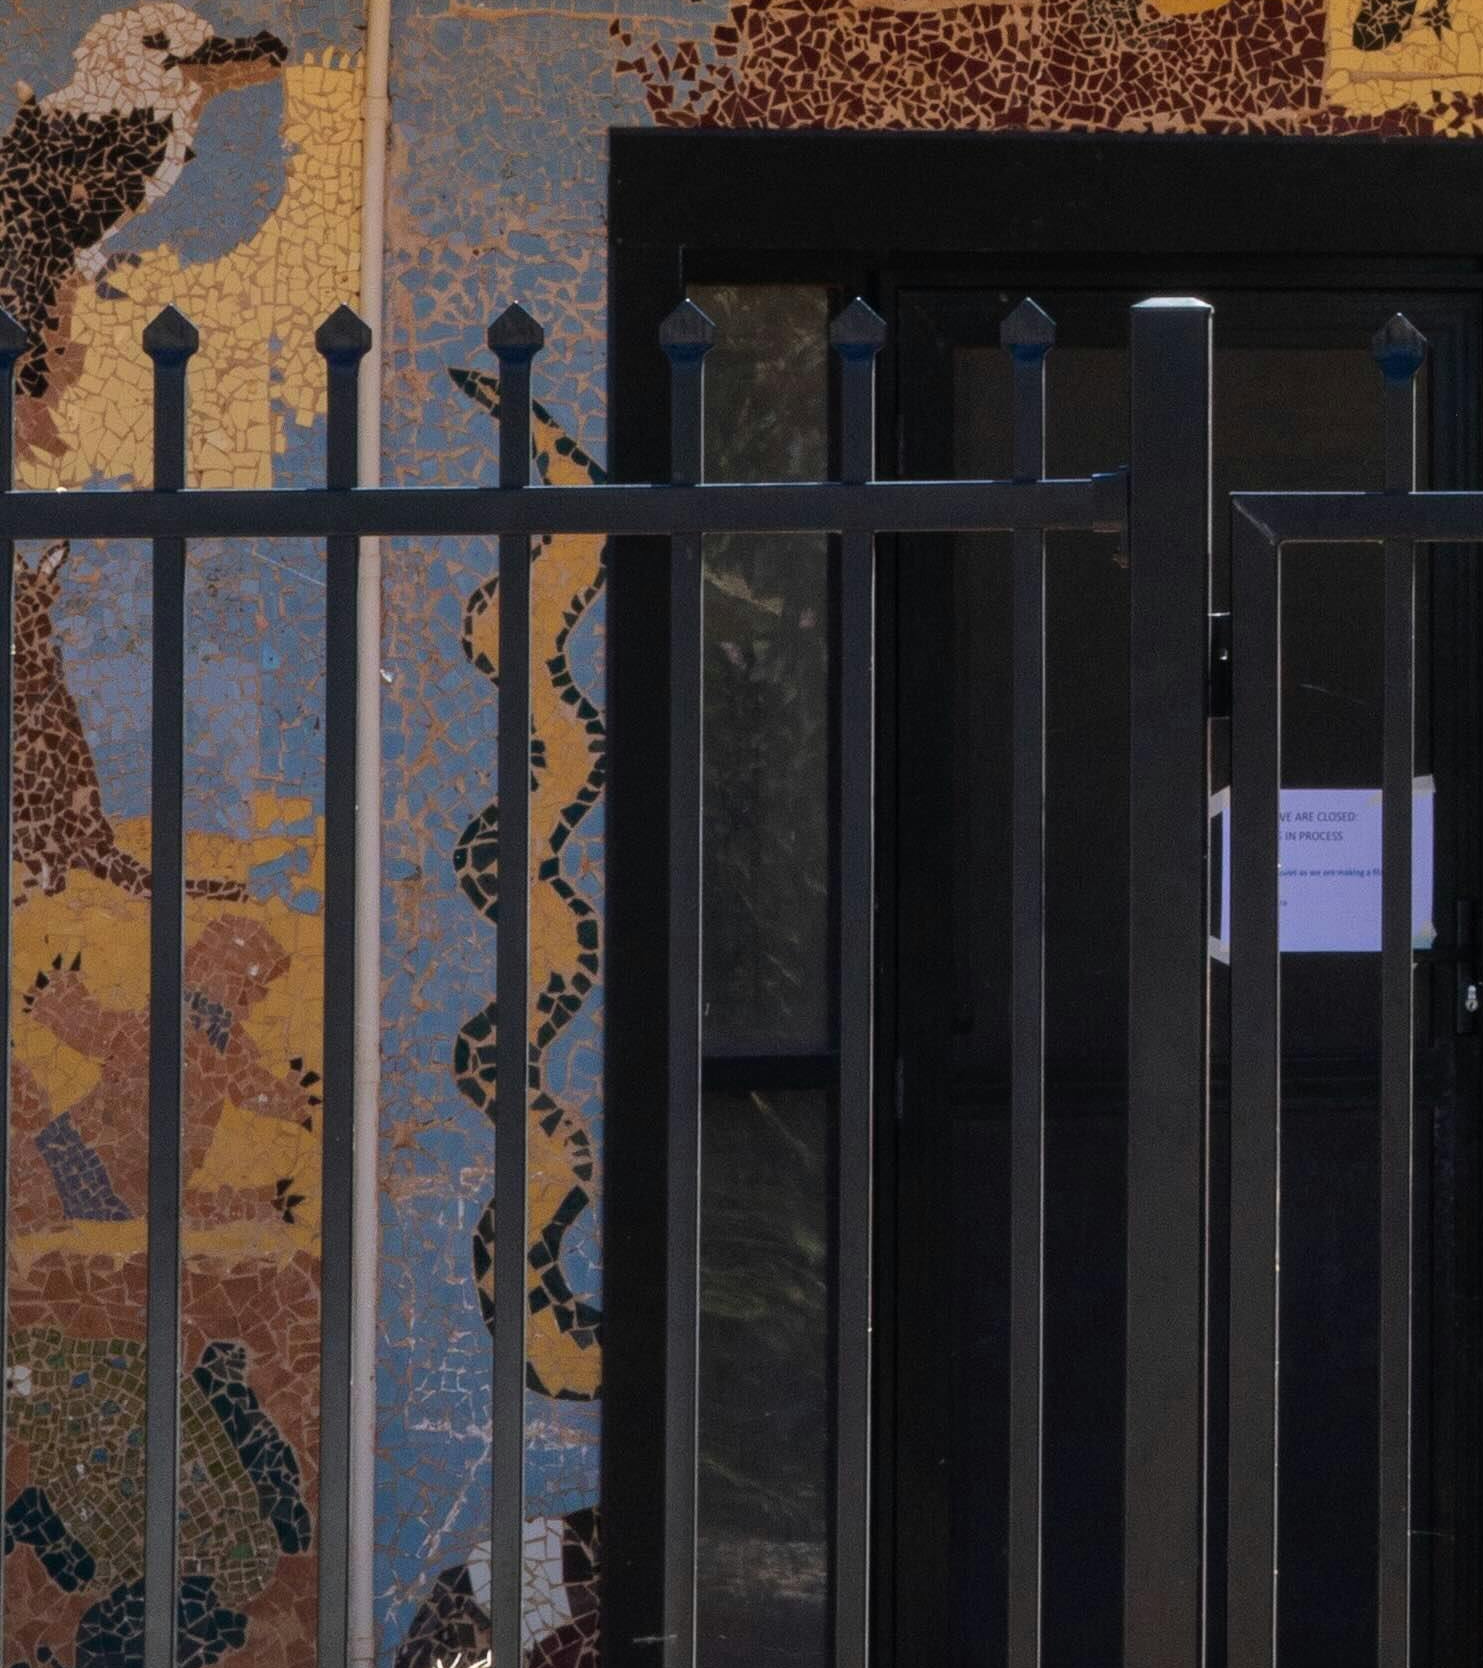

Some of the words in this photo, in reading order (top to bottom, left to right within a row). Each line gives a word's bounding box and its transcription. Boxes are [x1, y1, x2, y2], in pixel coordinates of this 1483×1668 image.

[1295, 812, 1313, 822] ARE
[1285, 831, 1297, 841] IN
[1299, 831, 1343, 840] PROCESS
